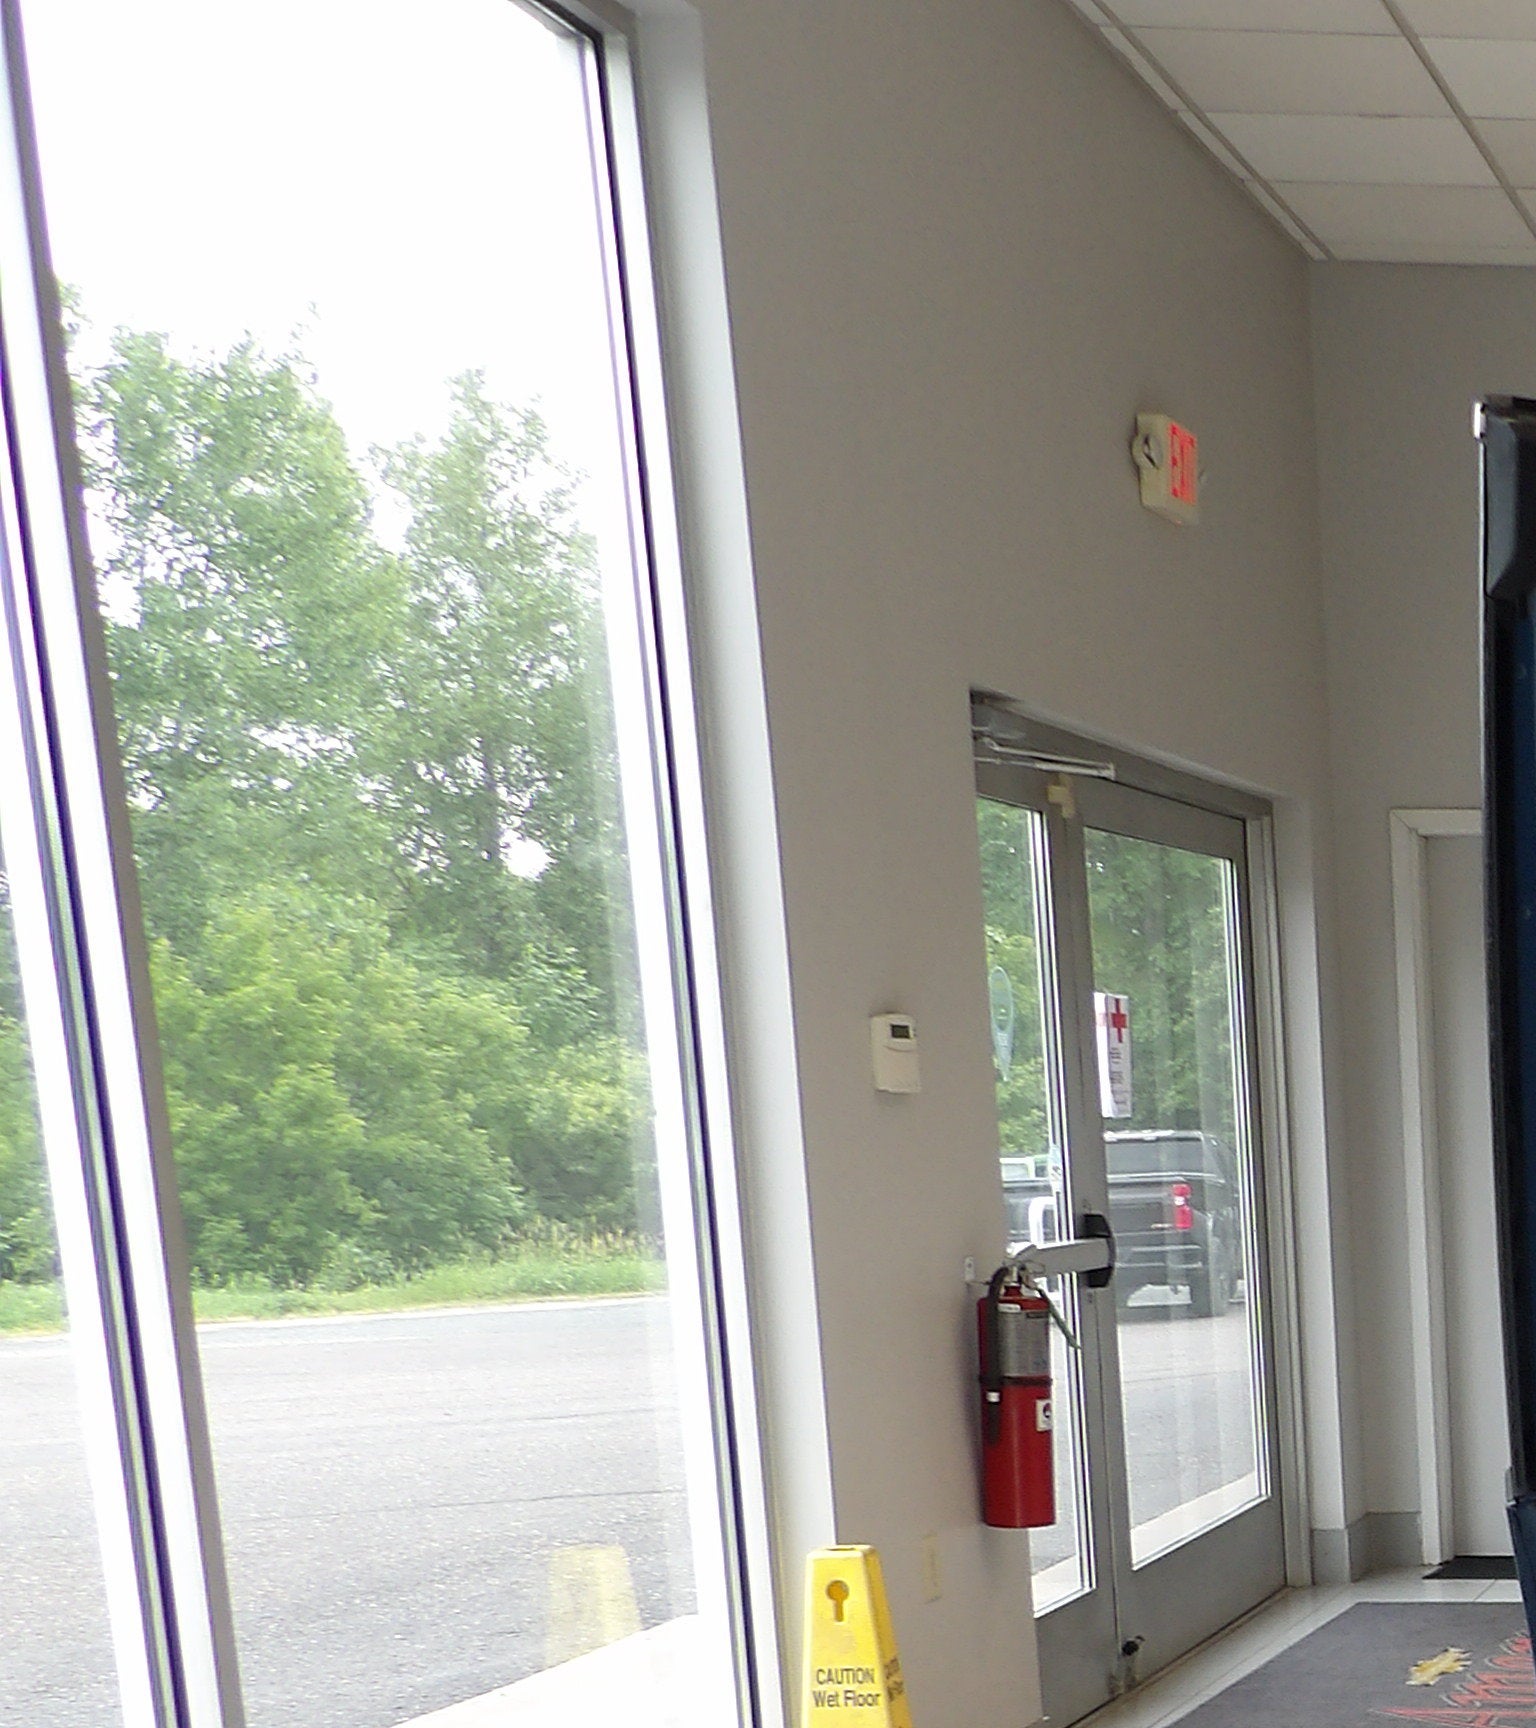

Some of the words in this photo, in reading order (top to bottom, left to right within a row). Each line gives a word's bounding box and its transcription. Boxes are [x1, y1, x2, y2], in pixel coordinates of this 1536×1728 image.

[816, 1667, 875, 1685] CAUTION
[812, 1690, 840, 1707] Wet
[843, 1689, 881, 1707] Floor
